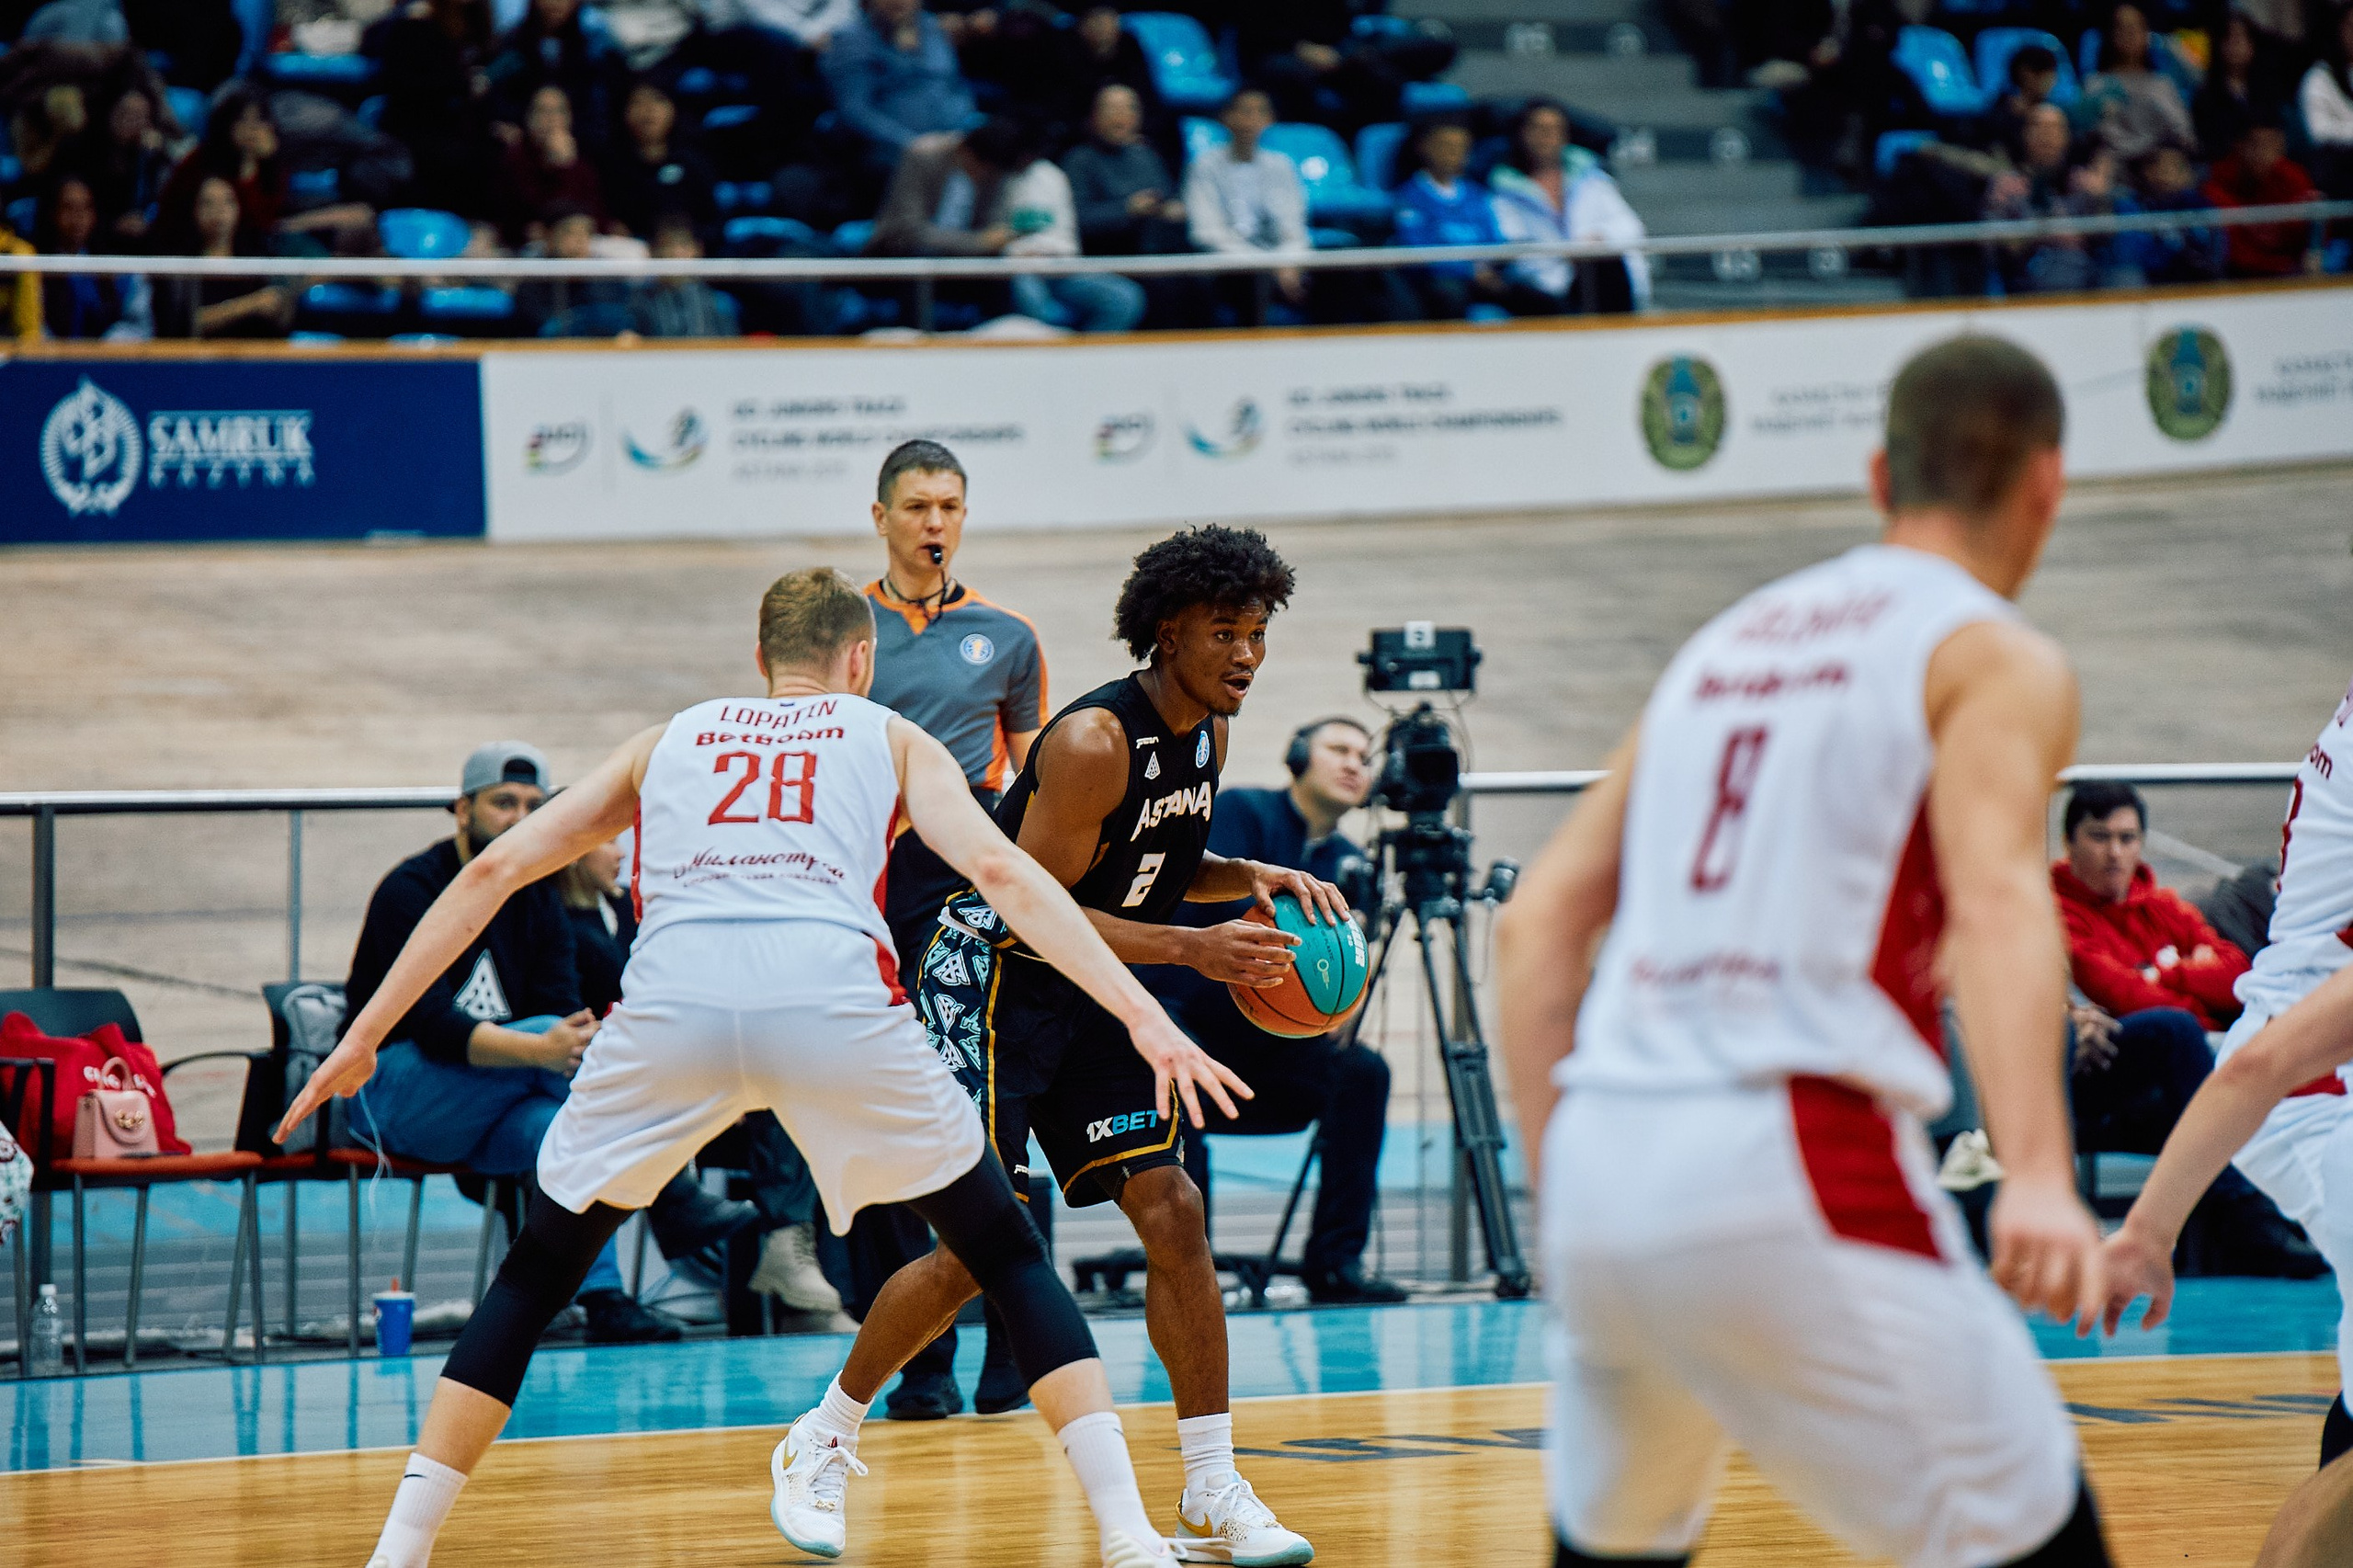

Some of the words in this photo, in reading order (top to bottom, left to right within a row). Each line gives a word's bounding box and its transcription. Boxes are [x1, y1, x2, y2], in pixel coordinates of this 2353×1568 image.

[720, 699, 837, 729] LOPATIN
[708, 750, 817, 825] 28
[1130, 781, 1212, 842] ASTANA
[1121, 851, 1165, 908] 2
[1086, 1110, 1159, 1142] 1XBET
